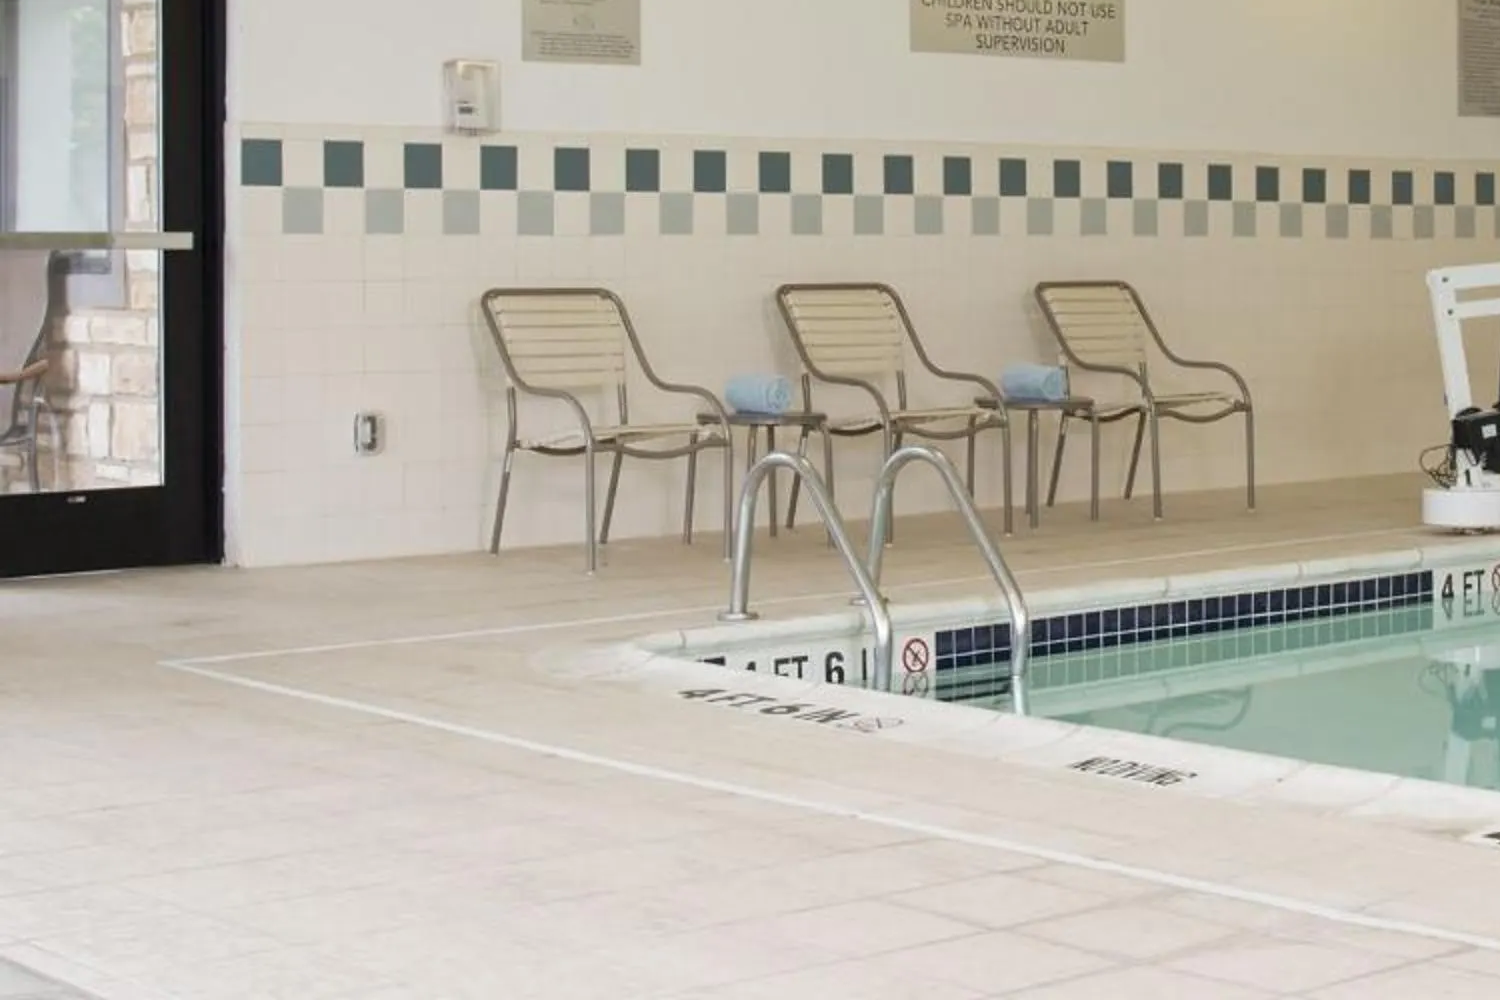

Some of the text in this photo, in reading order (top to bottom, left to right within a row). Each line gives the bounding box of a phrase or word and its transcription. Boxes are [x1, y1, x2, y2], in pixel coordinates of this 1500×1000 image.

[1057, 1, 1087, 17] NOT
[1091, 3, 1116, 19] USE
[945, 12, 1089, 36] SPA WITHOUT ADULT
[975, 34, 1065, 53] SUPERVISION
[1441, 568, 1485, 598] 4 FT
[825, 651, 844, 685] 6
[705, 693, 778, 707] FT
[760, 703, 815, 714] 6
